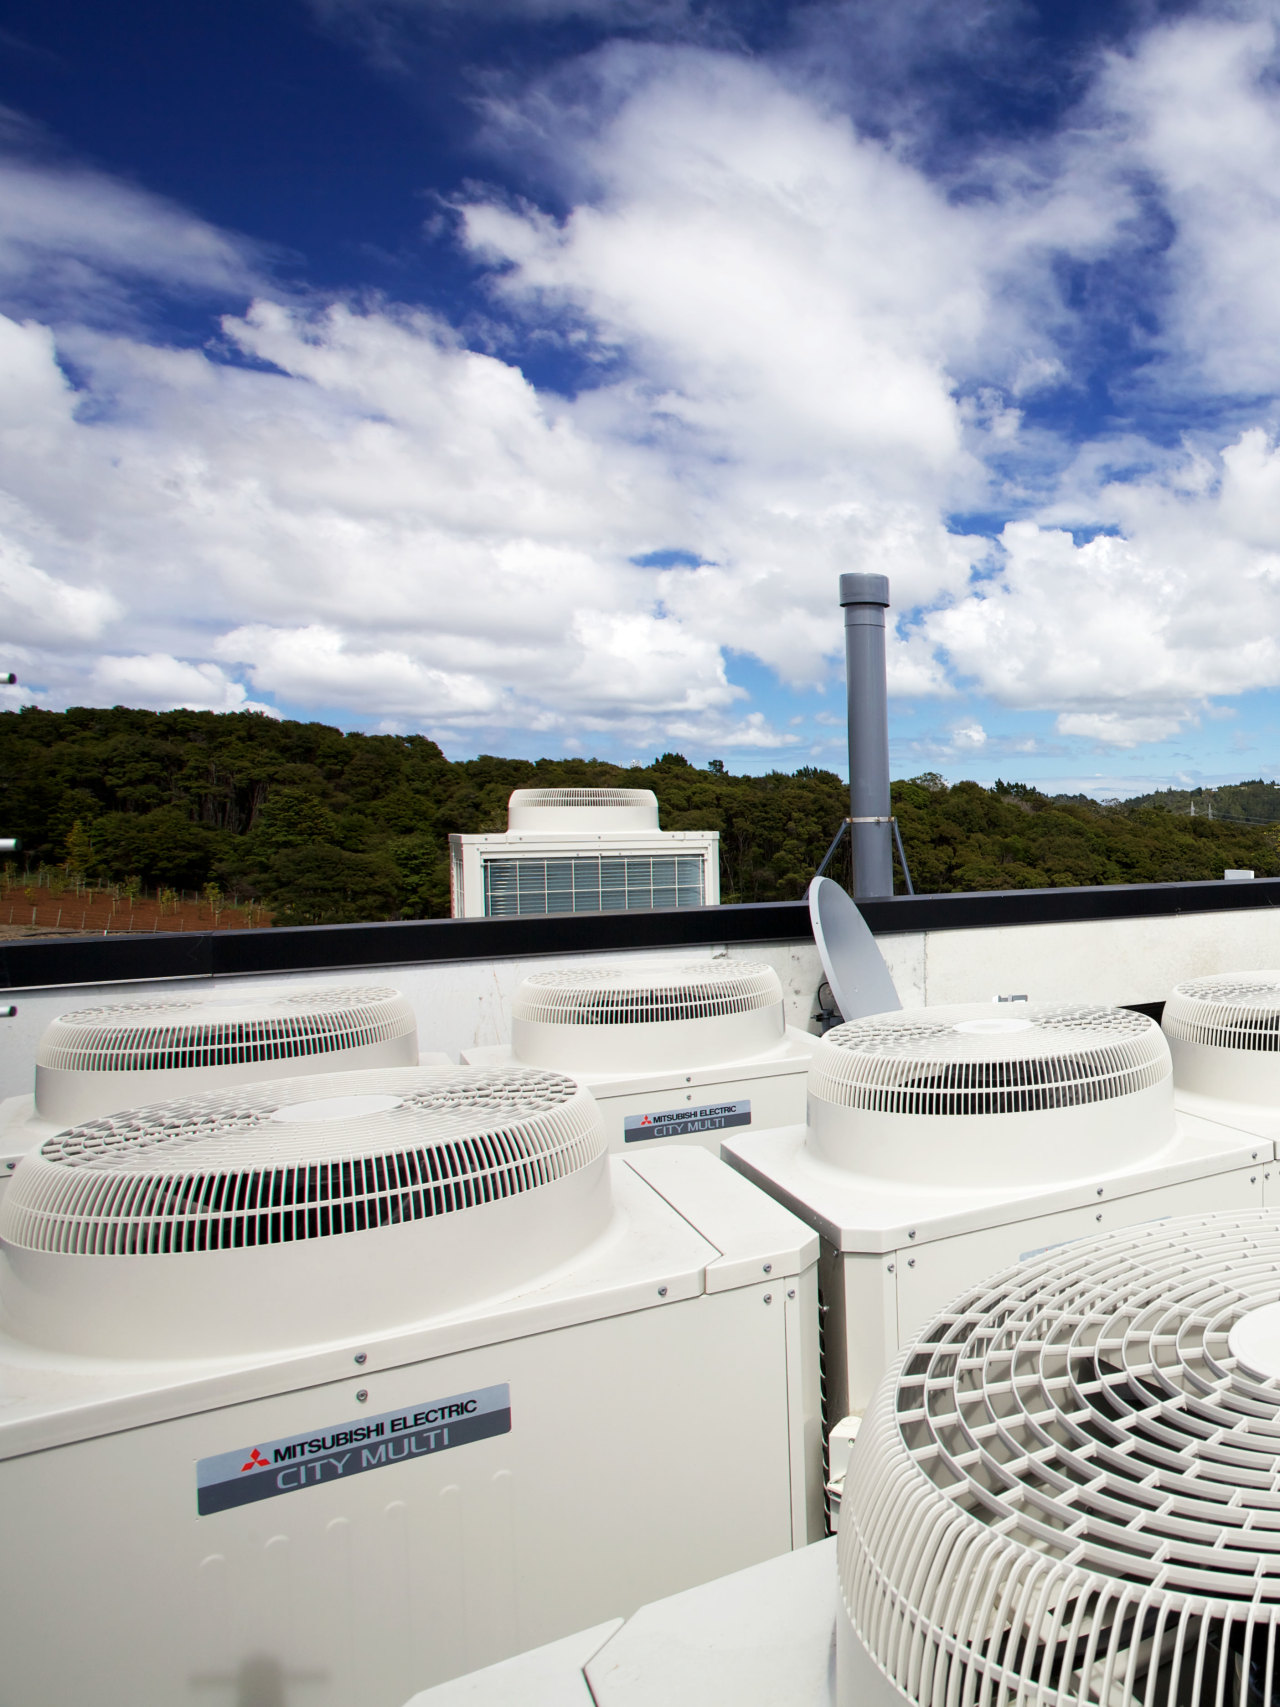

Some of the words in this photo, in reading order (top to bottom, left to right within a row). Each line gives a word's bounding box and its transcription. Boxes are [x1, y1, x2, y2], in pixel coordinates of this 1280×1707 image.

[653, 1111, 698, 1124] MITSUBISHI
[699, 1105, 737, 1117] ELECTRIC
[654, 1123, 684, 1137] CITY
[687, 1117, 725, 1132] MULTI
[273, 1422, 385, 1463] MITSUBISHI
[390, 1399, 478, 1433] ELECTRIC
[276, 1453, 351, 1490] CITY
[361, 1427, 450, 1469] MULTI
